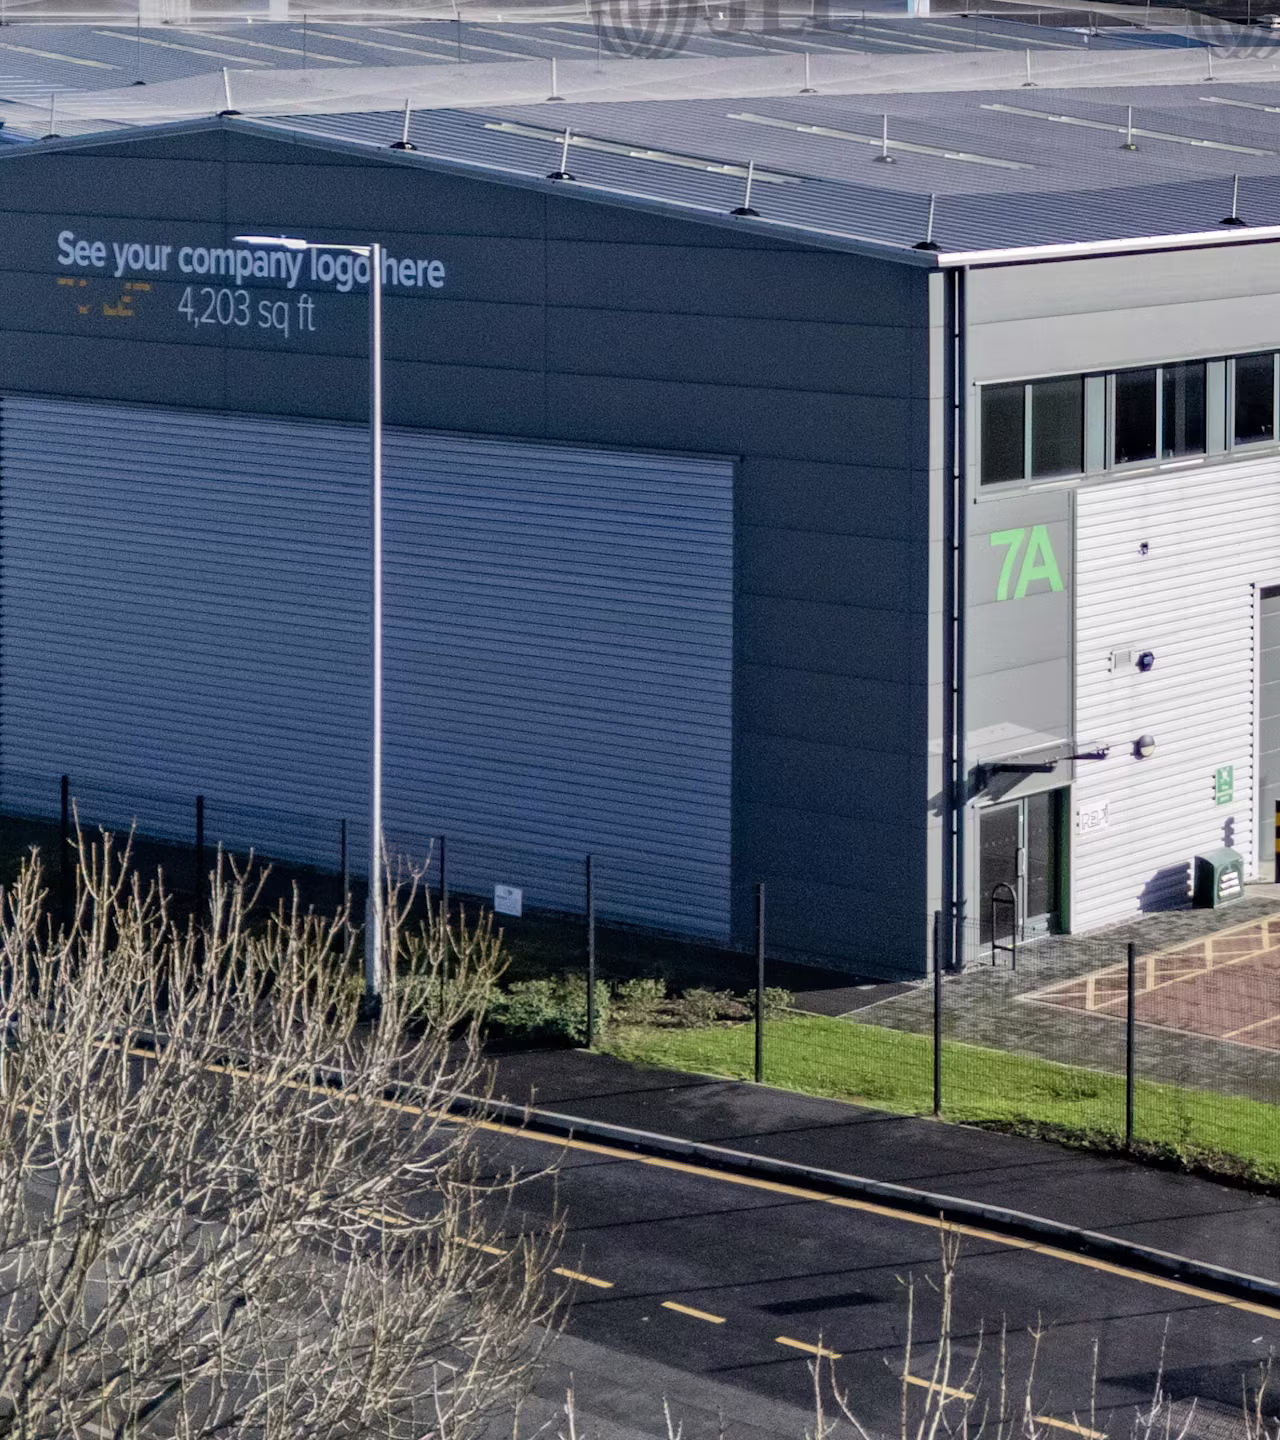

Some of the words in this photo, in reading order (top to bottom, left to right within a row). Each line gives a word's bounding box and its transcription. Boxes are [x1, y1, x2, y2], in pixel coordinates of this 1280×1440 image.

[57, 230, 106, 266] See
[112, 242, 171, 277] your
[178, 246, 303, 288] company
[311, 247, 371, 292] logo
[381, 249, 445, 288] here
[178, 286, 250, 328] 4,203
[258, 300, 289, 337] sq
[297, 294, 316, 331] ft
[991, 526, 1064, 601] 7A
